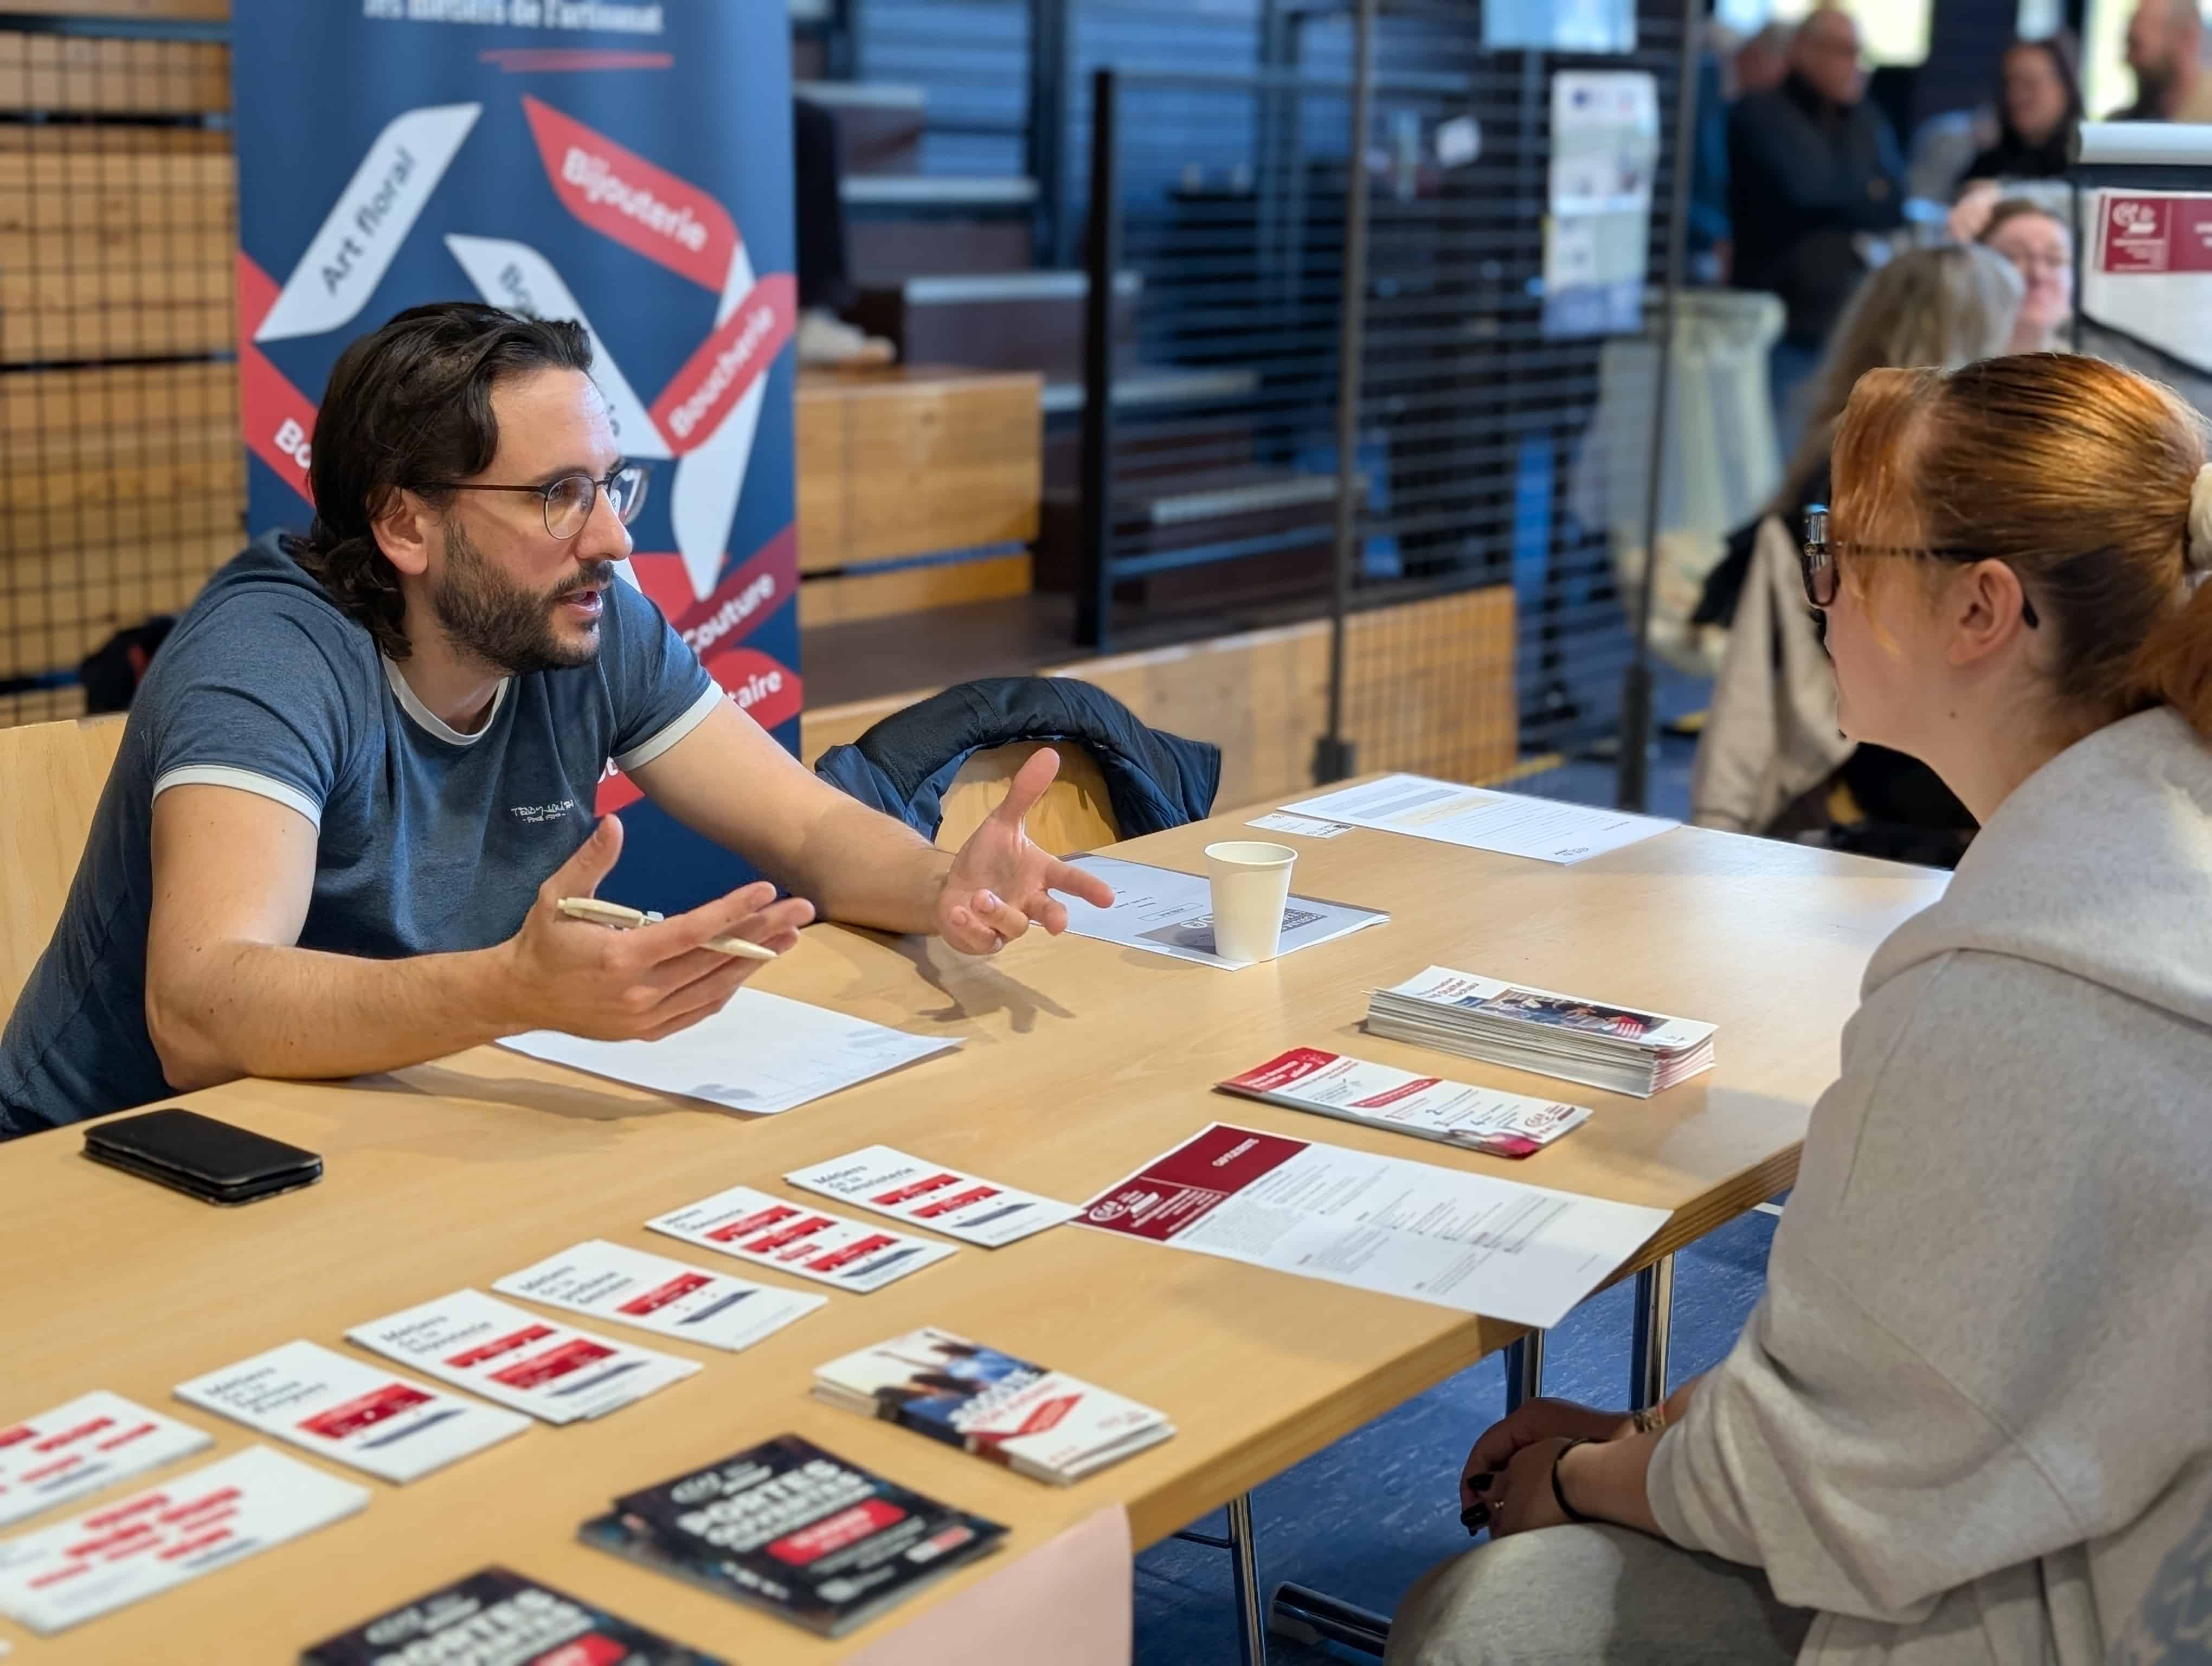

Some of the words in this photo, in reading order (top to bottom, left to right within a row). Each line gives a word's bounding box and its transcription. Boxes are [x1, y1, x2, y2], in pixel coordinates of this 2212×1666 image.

[322, 239, 364, 297] Art
[355, 144, 416, 236] floral
[562, 146, 708, 252] Bijouterie
[667, 304, 775, 438] Boucherie
[681, 574, 775, 653] Couture
